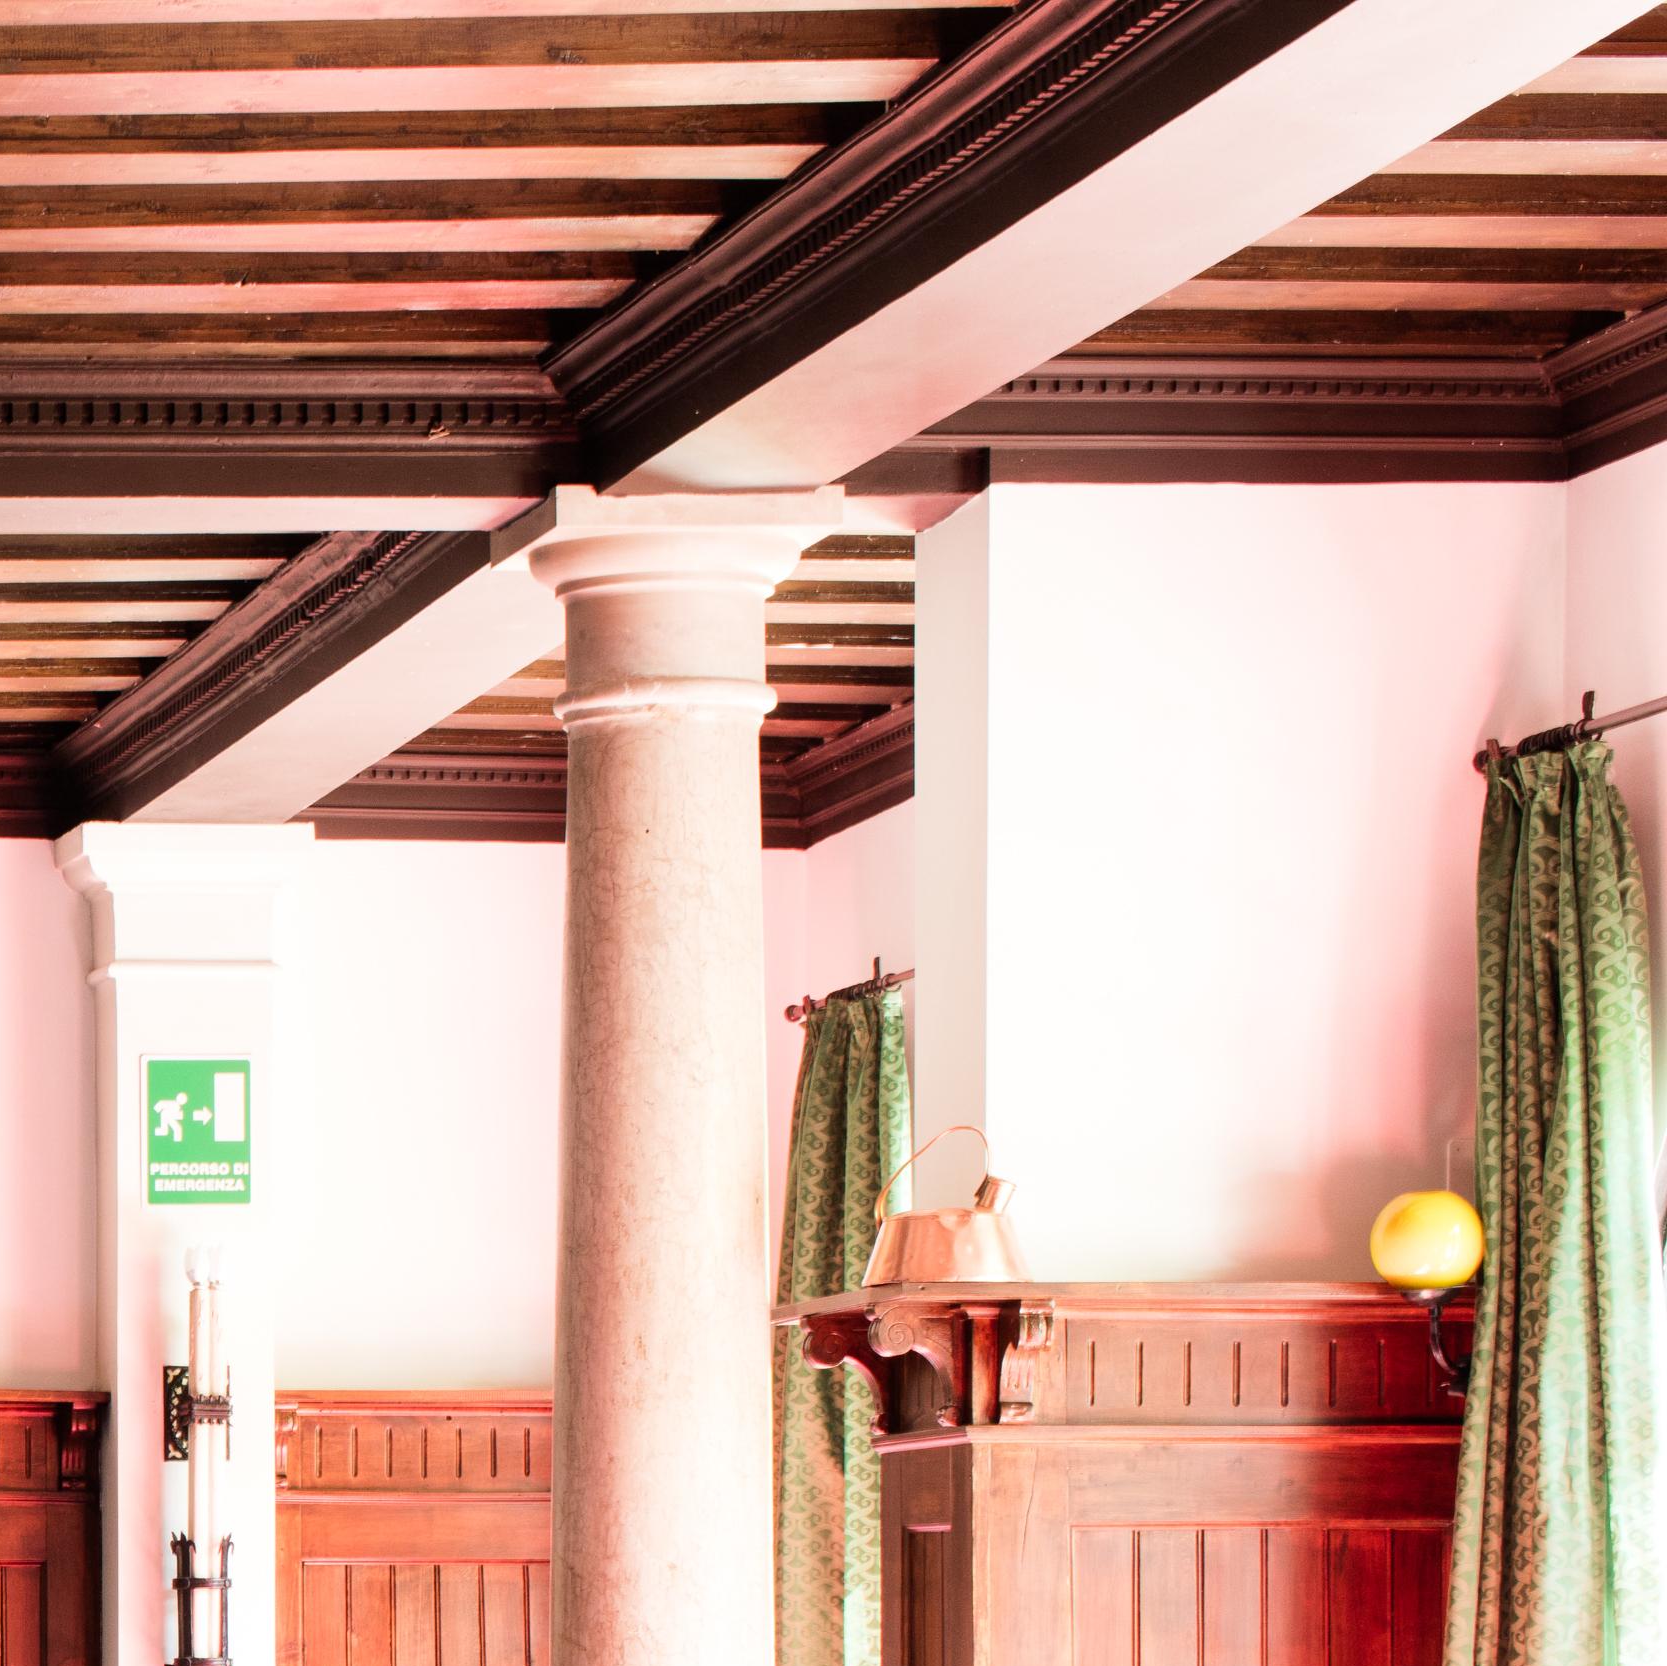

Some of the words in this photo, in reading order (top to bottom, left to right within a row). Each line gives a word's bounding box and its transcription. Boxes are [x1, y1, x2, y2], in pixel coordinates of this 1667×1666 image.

[149, 1162, 229, 1176] PERCORSO
[233, 1162, 249, 1176] DI
[154, 1178, 245, 1191] EMERGENZA
